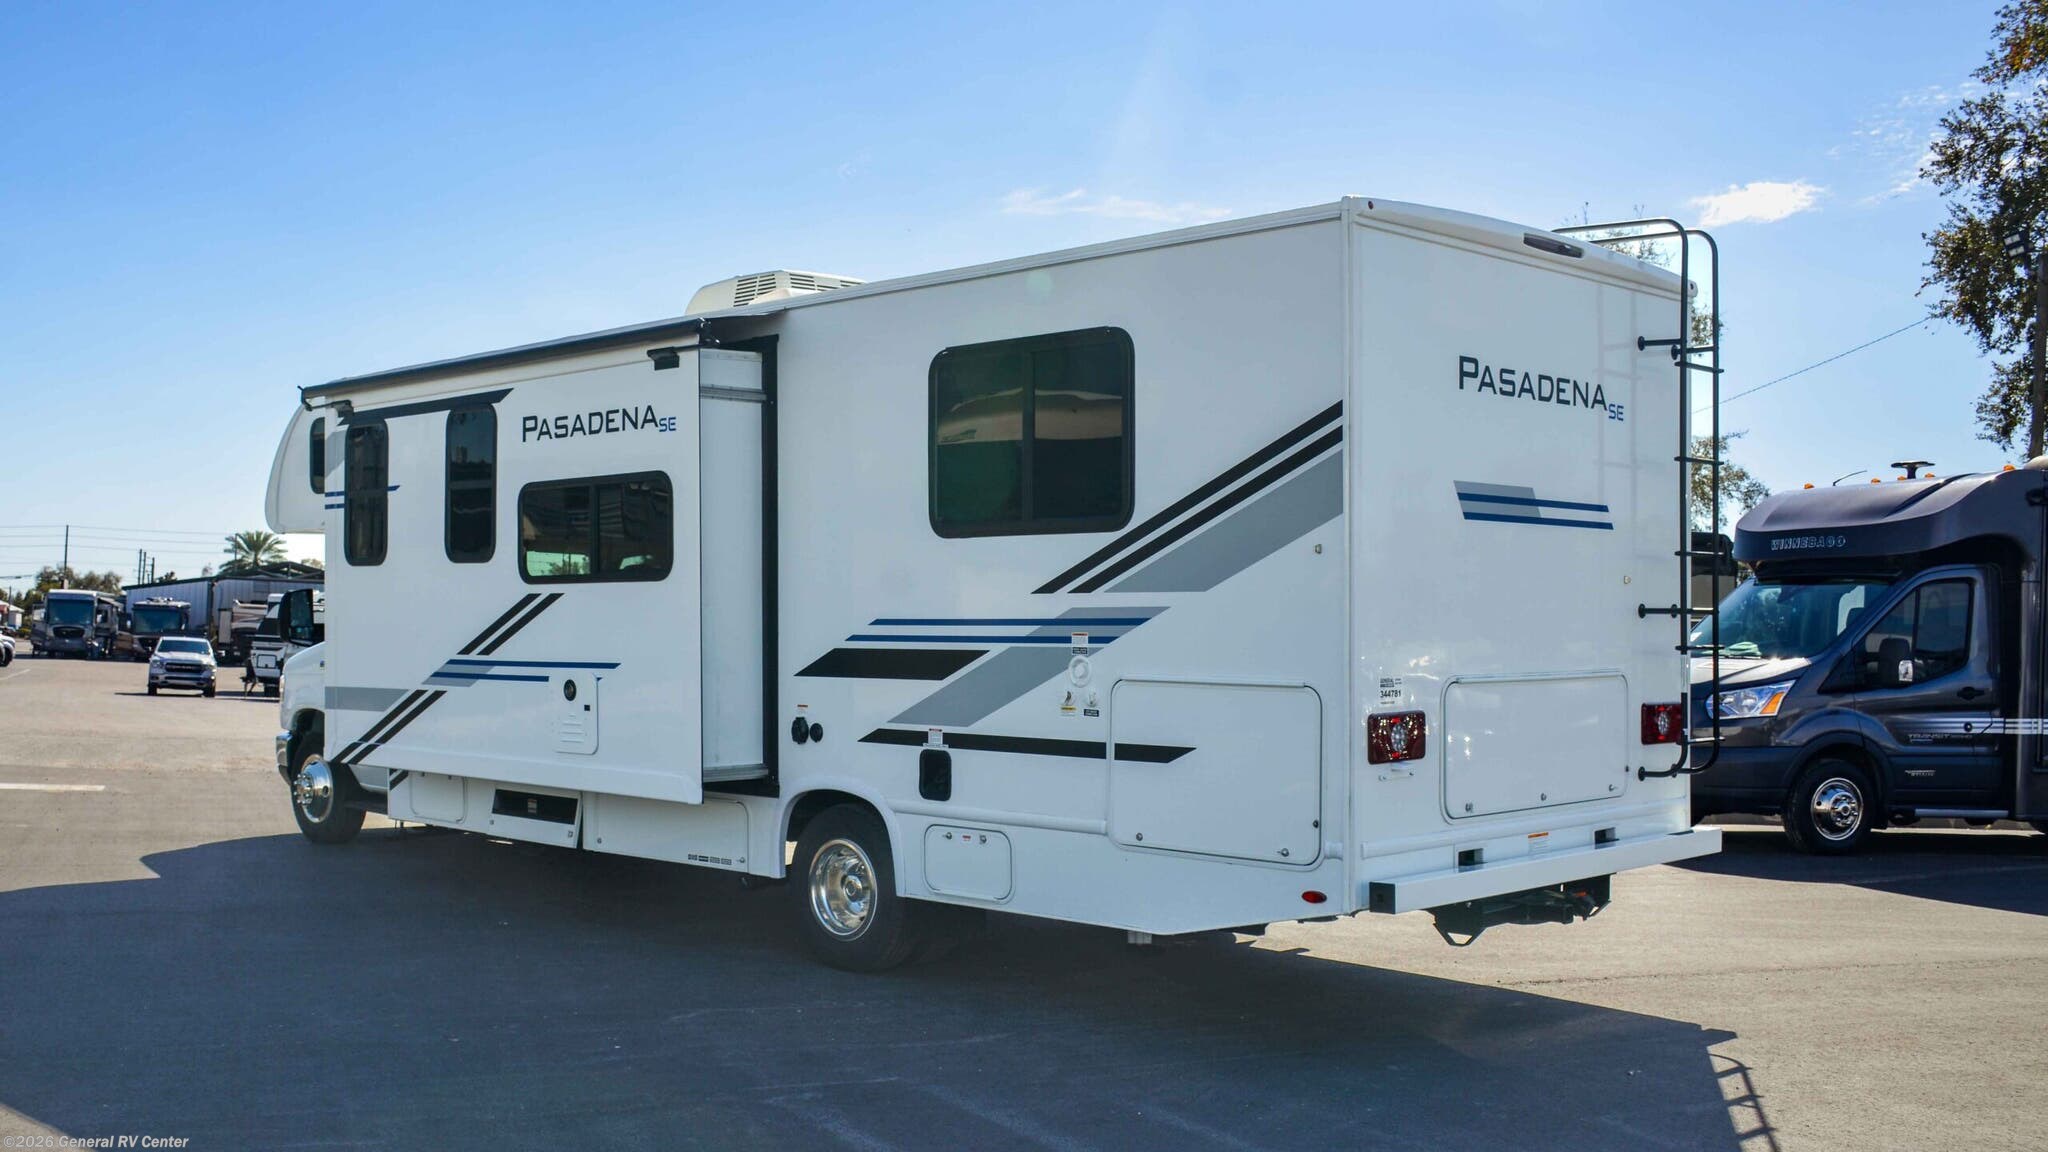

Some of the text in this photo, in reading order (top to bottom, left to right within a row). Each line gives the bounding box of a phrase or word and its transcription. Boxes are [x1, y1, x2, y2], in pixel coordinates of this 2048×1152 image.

[1459, 355, 1625, 422] PASADENA SE
[522, 405, 677, 442] PASADENA SE
